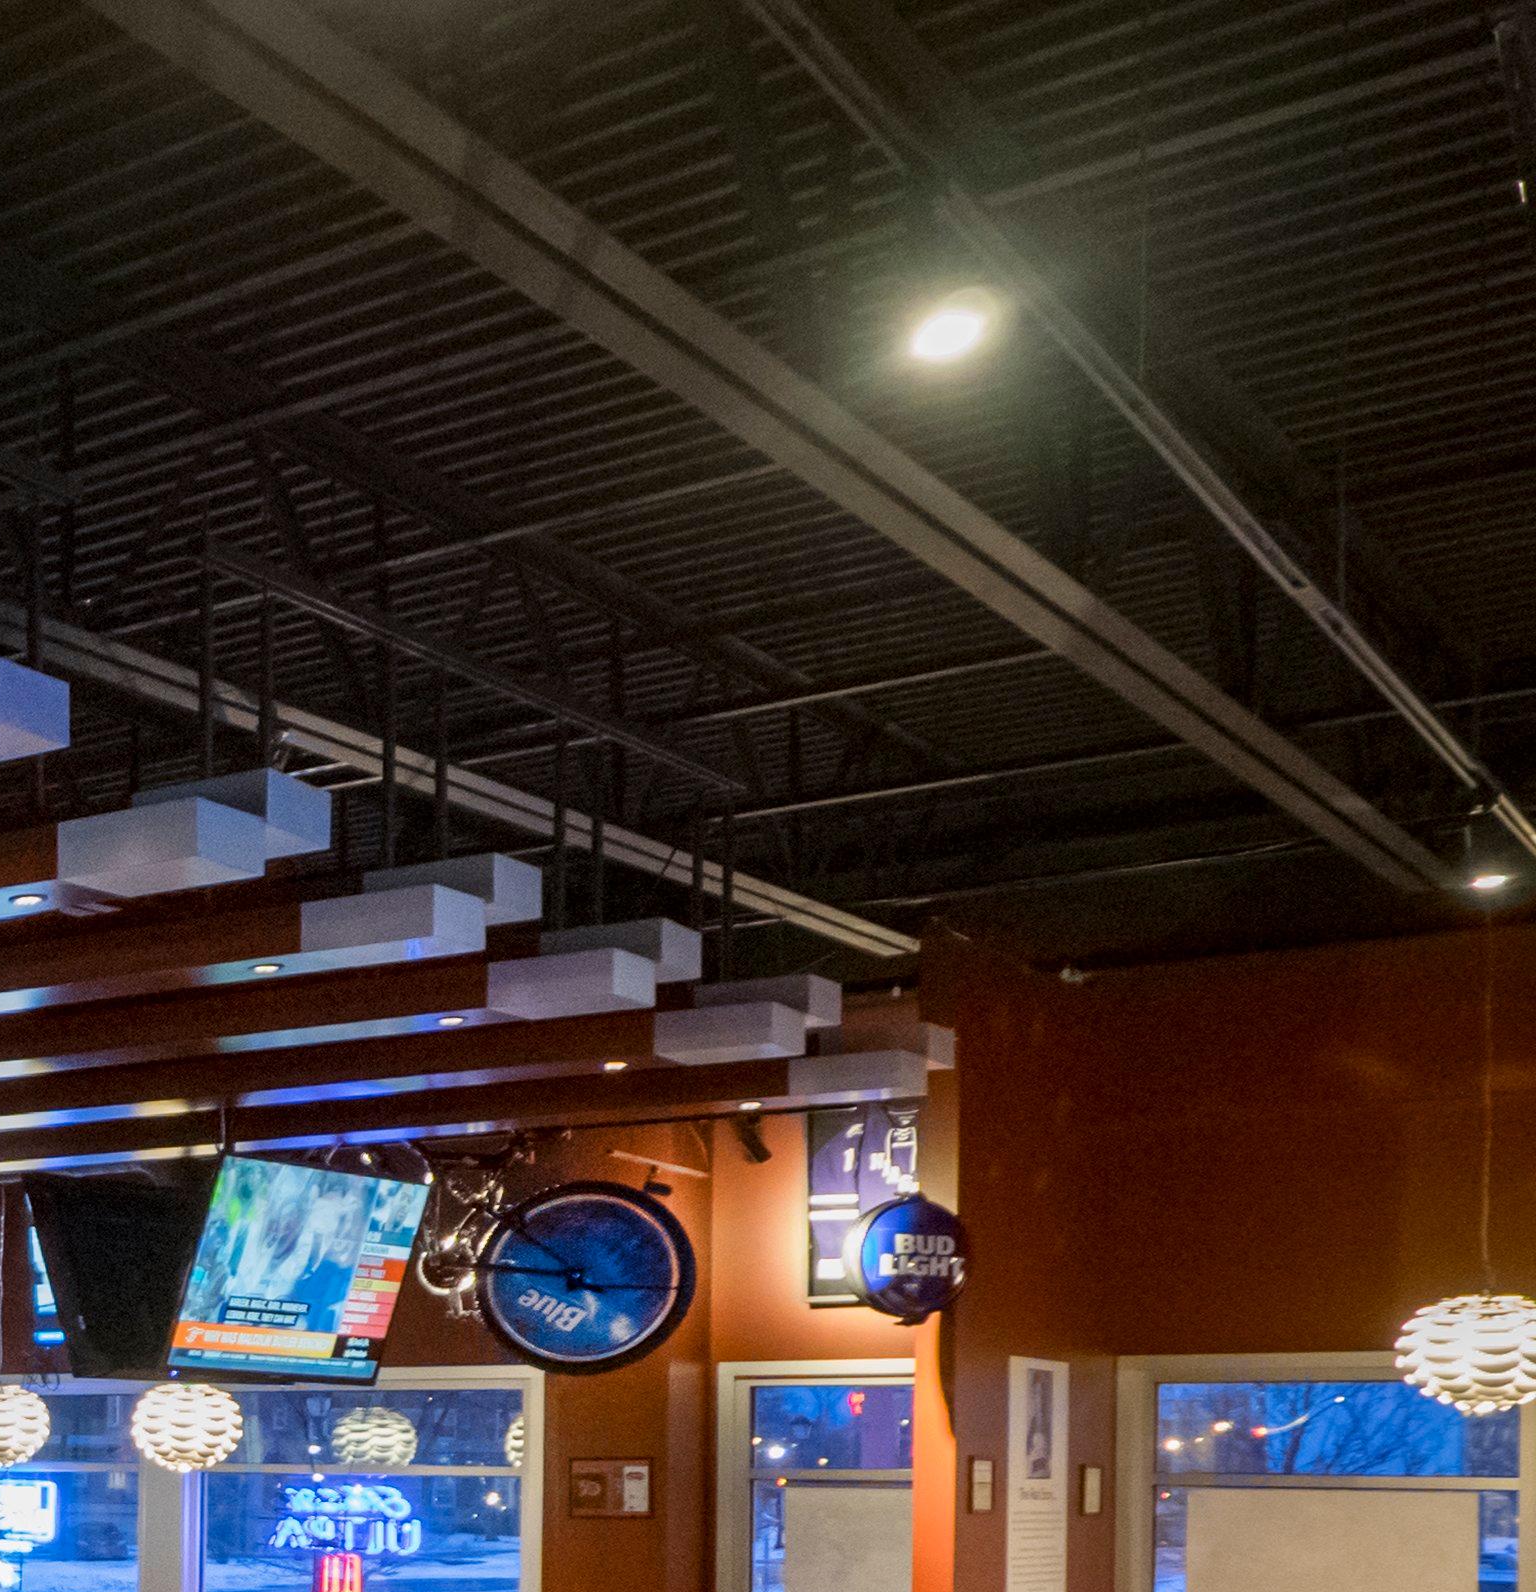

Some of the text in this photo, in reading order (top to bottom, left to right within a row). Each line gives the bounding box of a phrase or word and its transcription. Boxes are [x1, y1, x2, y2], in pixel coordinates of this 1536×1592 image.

[894, 1233, 955, 1255] BUD
[879, 1253, 965, 1278] LIGHT
[518, 1289, 588, 1332] Blue
